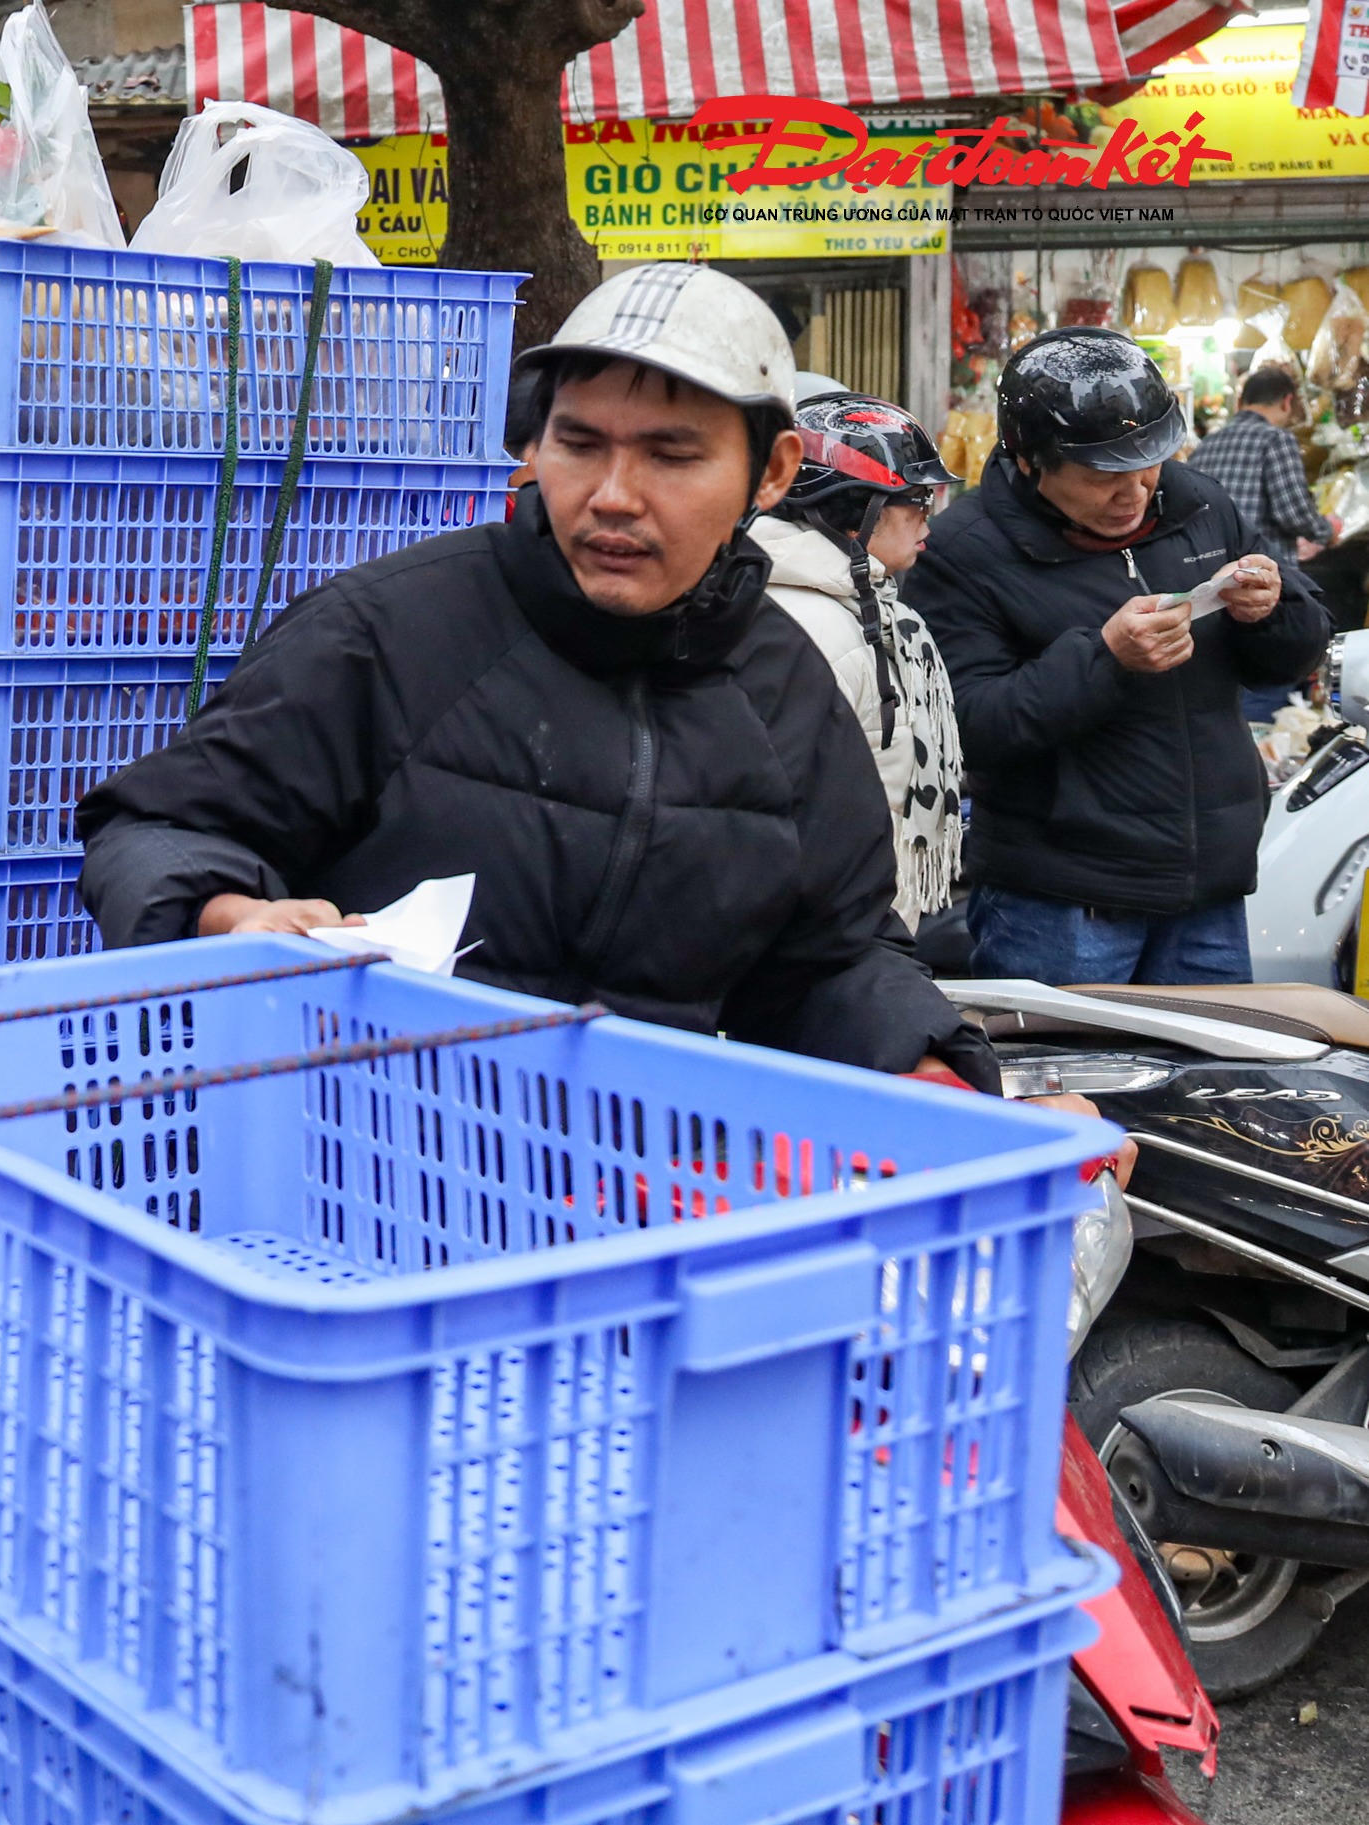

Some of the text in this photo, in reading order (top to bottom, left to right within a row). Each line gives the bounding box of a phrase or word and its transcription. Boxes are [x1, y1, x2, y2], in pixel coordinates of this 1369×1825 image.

[1175, 82, 1216, 98] BAO
[585, 199, 652, 227] BÁNH
[618, 243, 652, 254] 0914
[656, 243, 680, 254] 811
[825, 237, 867, 251] THEO
[1185, 1088, 1343, 1101] LEAD
